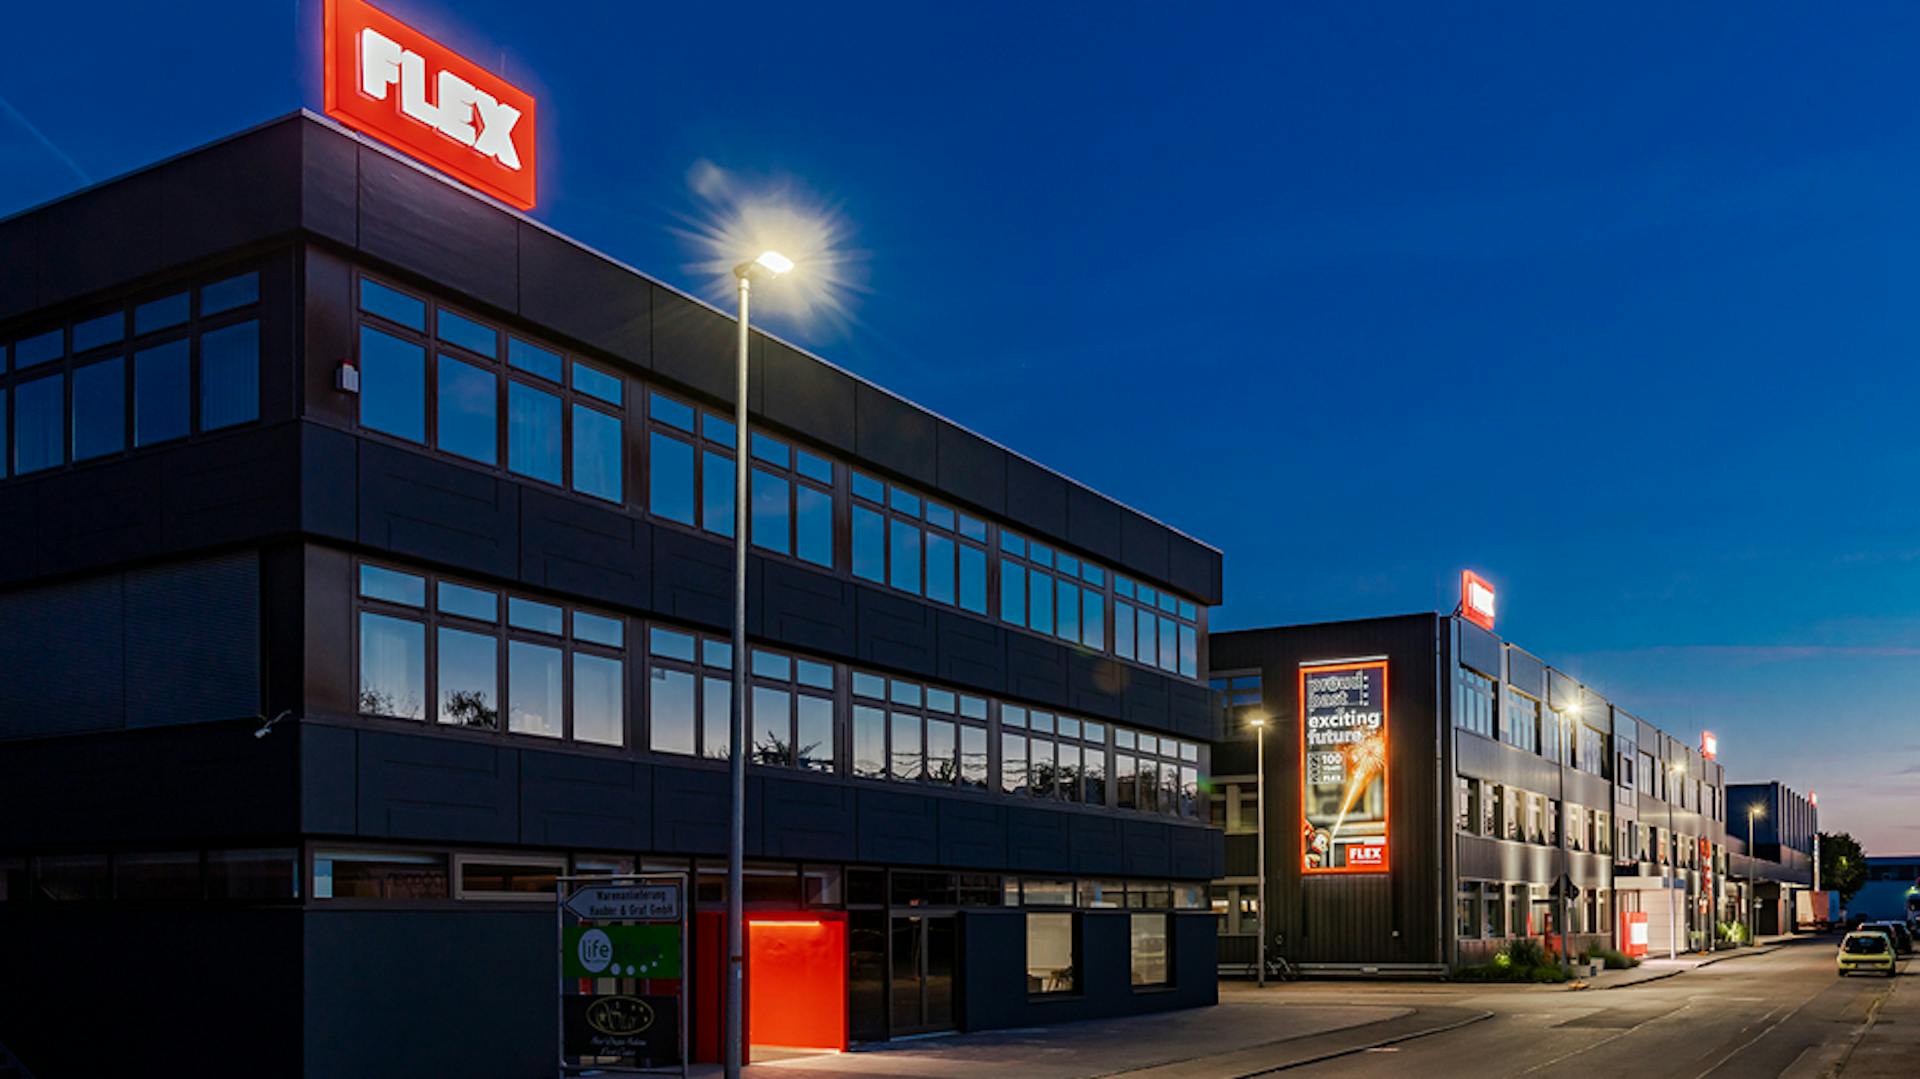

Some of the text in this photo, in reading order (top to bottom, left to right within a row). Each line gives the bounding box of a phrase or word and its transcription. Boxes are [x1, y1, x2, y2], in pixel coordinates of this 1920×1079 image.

[356, 27, 522, 171] FLEX
[1308, 710, 1380, 728] exciting
[1307, 728, 1363, 745] future
[1349, 847, 1382, 859] FLEX
